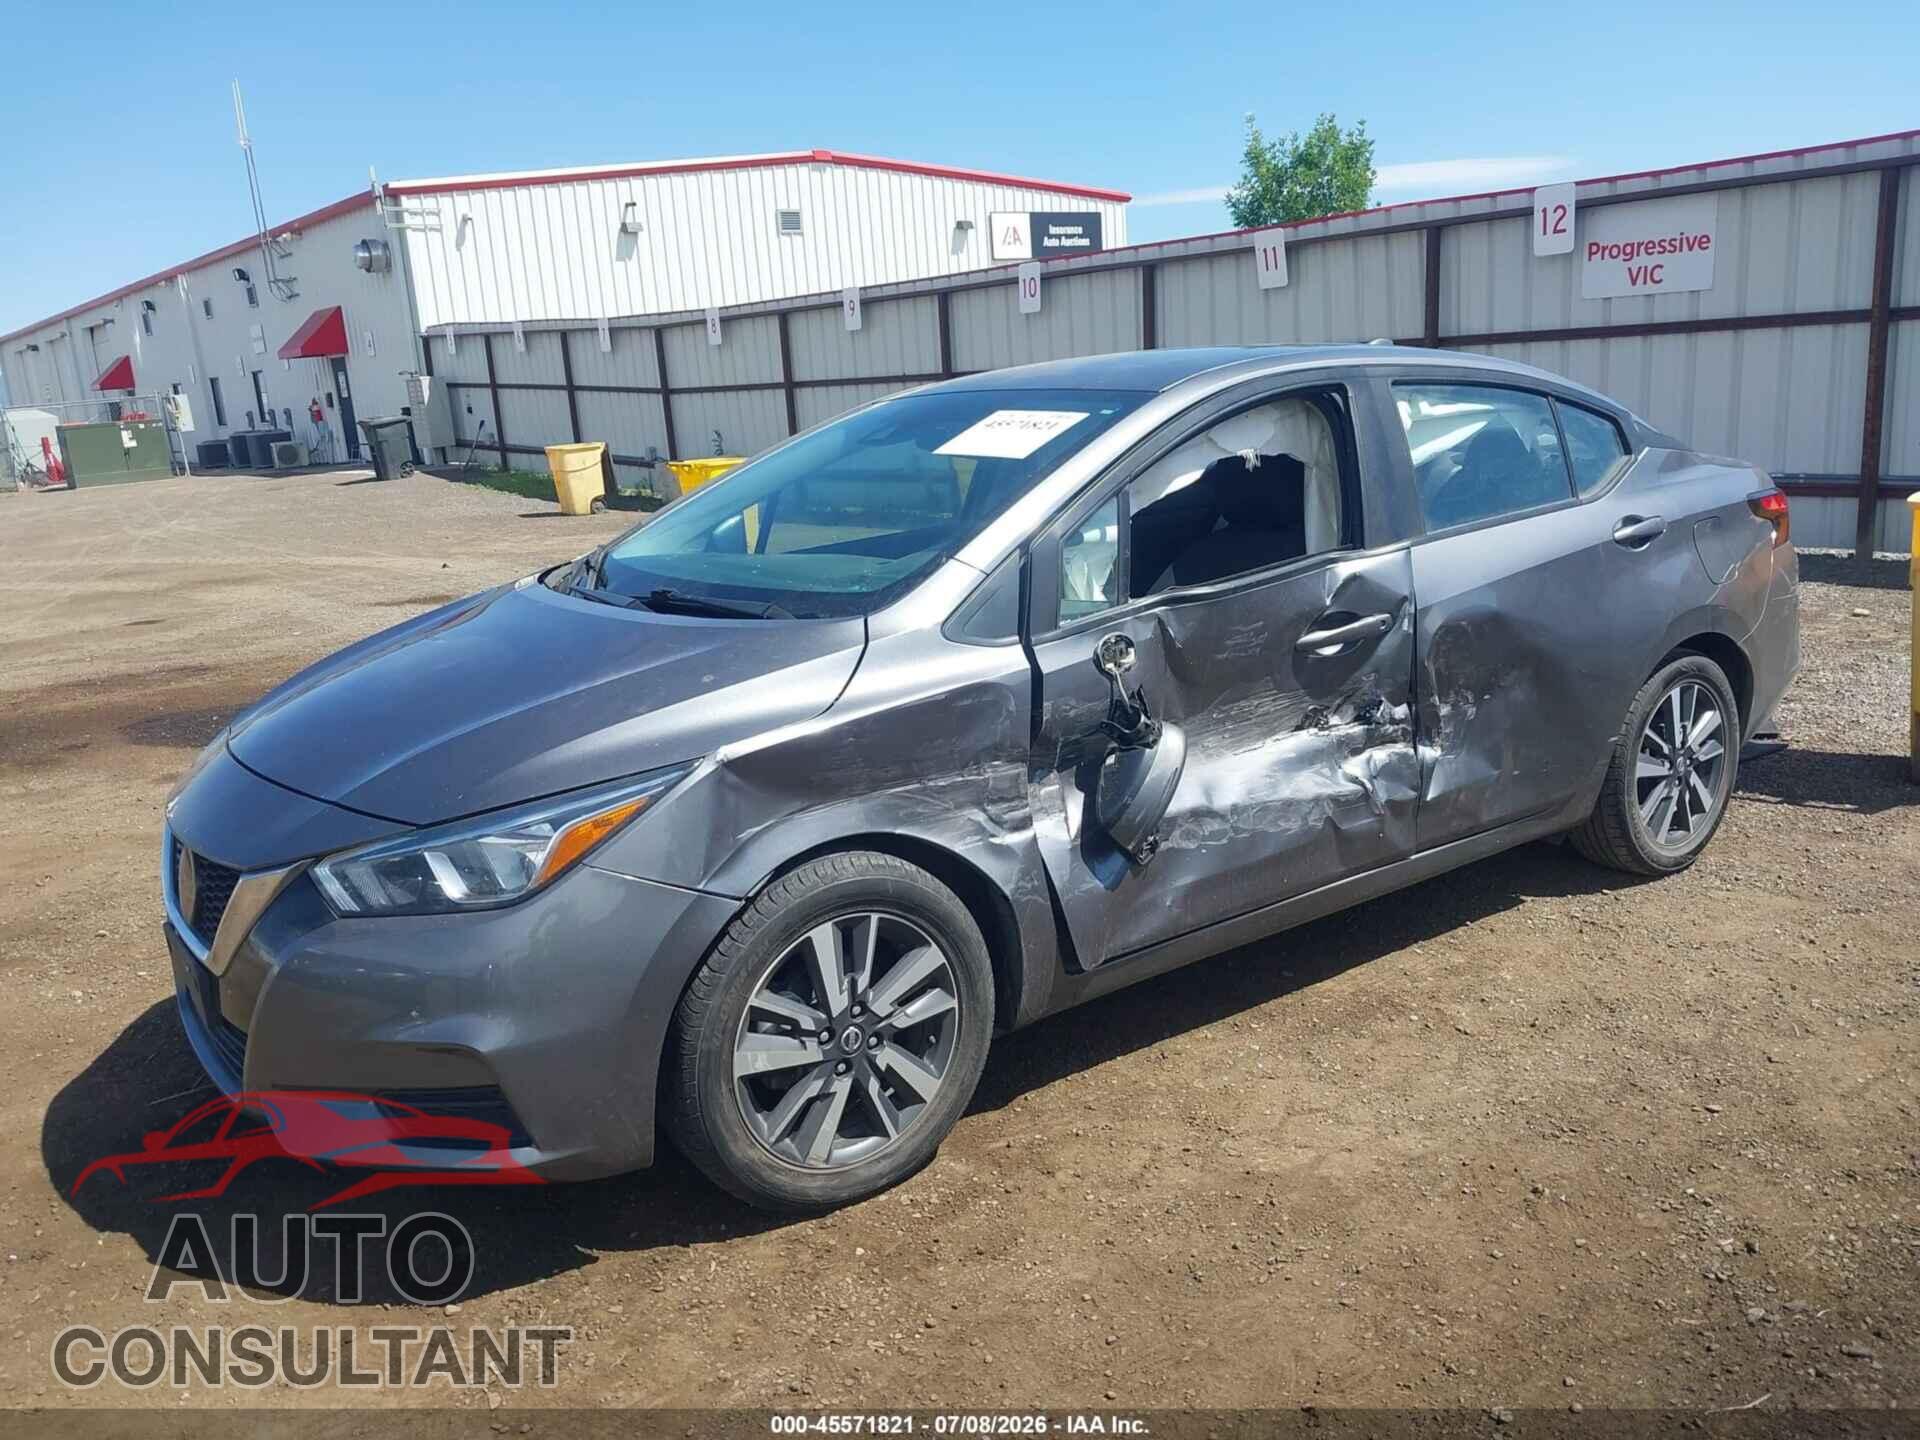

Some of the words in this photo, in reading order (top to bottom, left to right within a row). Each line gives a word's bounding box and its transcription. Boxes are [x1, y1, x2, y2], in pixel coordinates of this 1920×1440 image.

[1541, 204, 1567, 236] 12
[1043, 236, 1060, 247] Auto
[1588, 232, 1711, 262] Progressive
[1263, 246, 1278, 272] 11
[1627, 264, 1664, 287] VIC
[1023, 277, 1037, 299] 10
[849, 300, 855, 317] 9
[711, 318, 717, 334] 8
